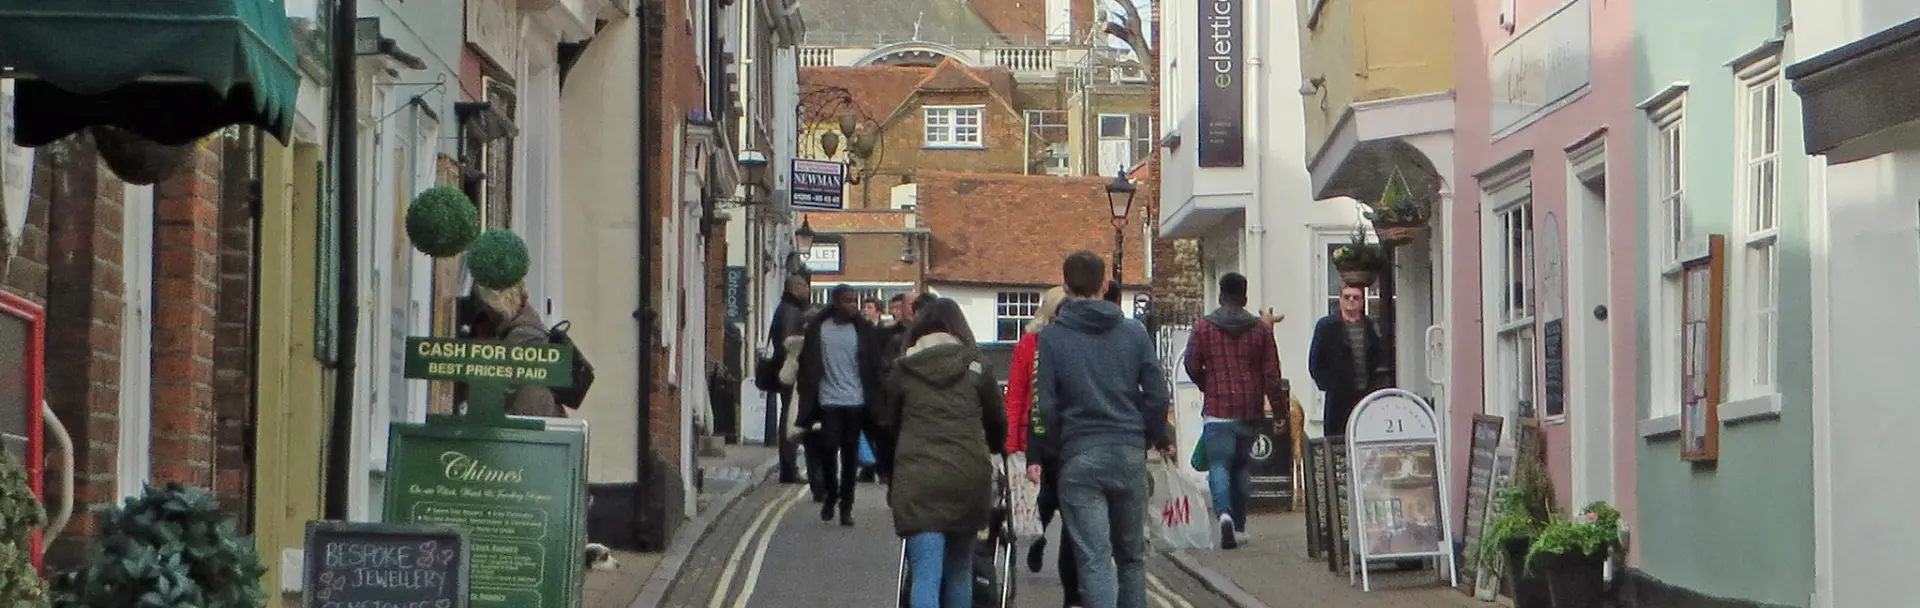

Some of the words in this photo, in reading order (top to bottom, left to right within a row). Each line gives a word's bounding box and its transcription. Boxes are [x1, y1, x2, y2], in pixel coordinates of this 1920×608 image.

[1208, 0, 1231, 88] eclettic
[794, 172, 840, 187] NEWMAN
[815, 249, 837, 260] LET
[418, 342, 466, 358] CASH
[471, 344, 506, 360] FOR
[511, 347, 560, 363] GOLD
[428, 362, 463, 375] BEST
[465, 364, 513, 378] PRICES
[517, 367, 547, 380] PAID
[1384, 418, 1404, 434] 21
[440, 451, 524, 483] Chimes
[326, 541, 414, 569] BESPOKE
[352, 567, 447, 597] JEWELLERY
